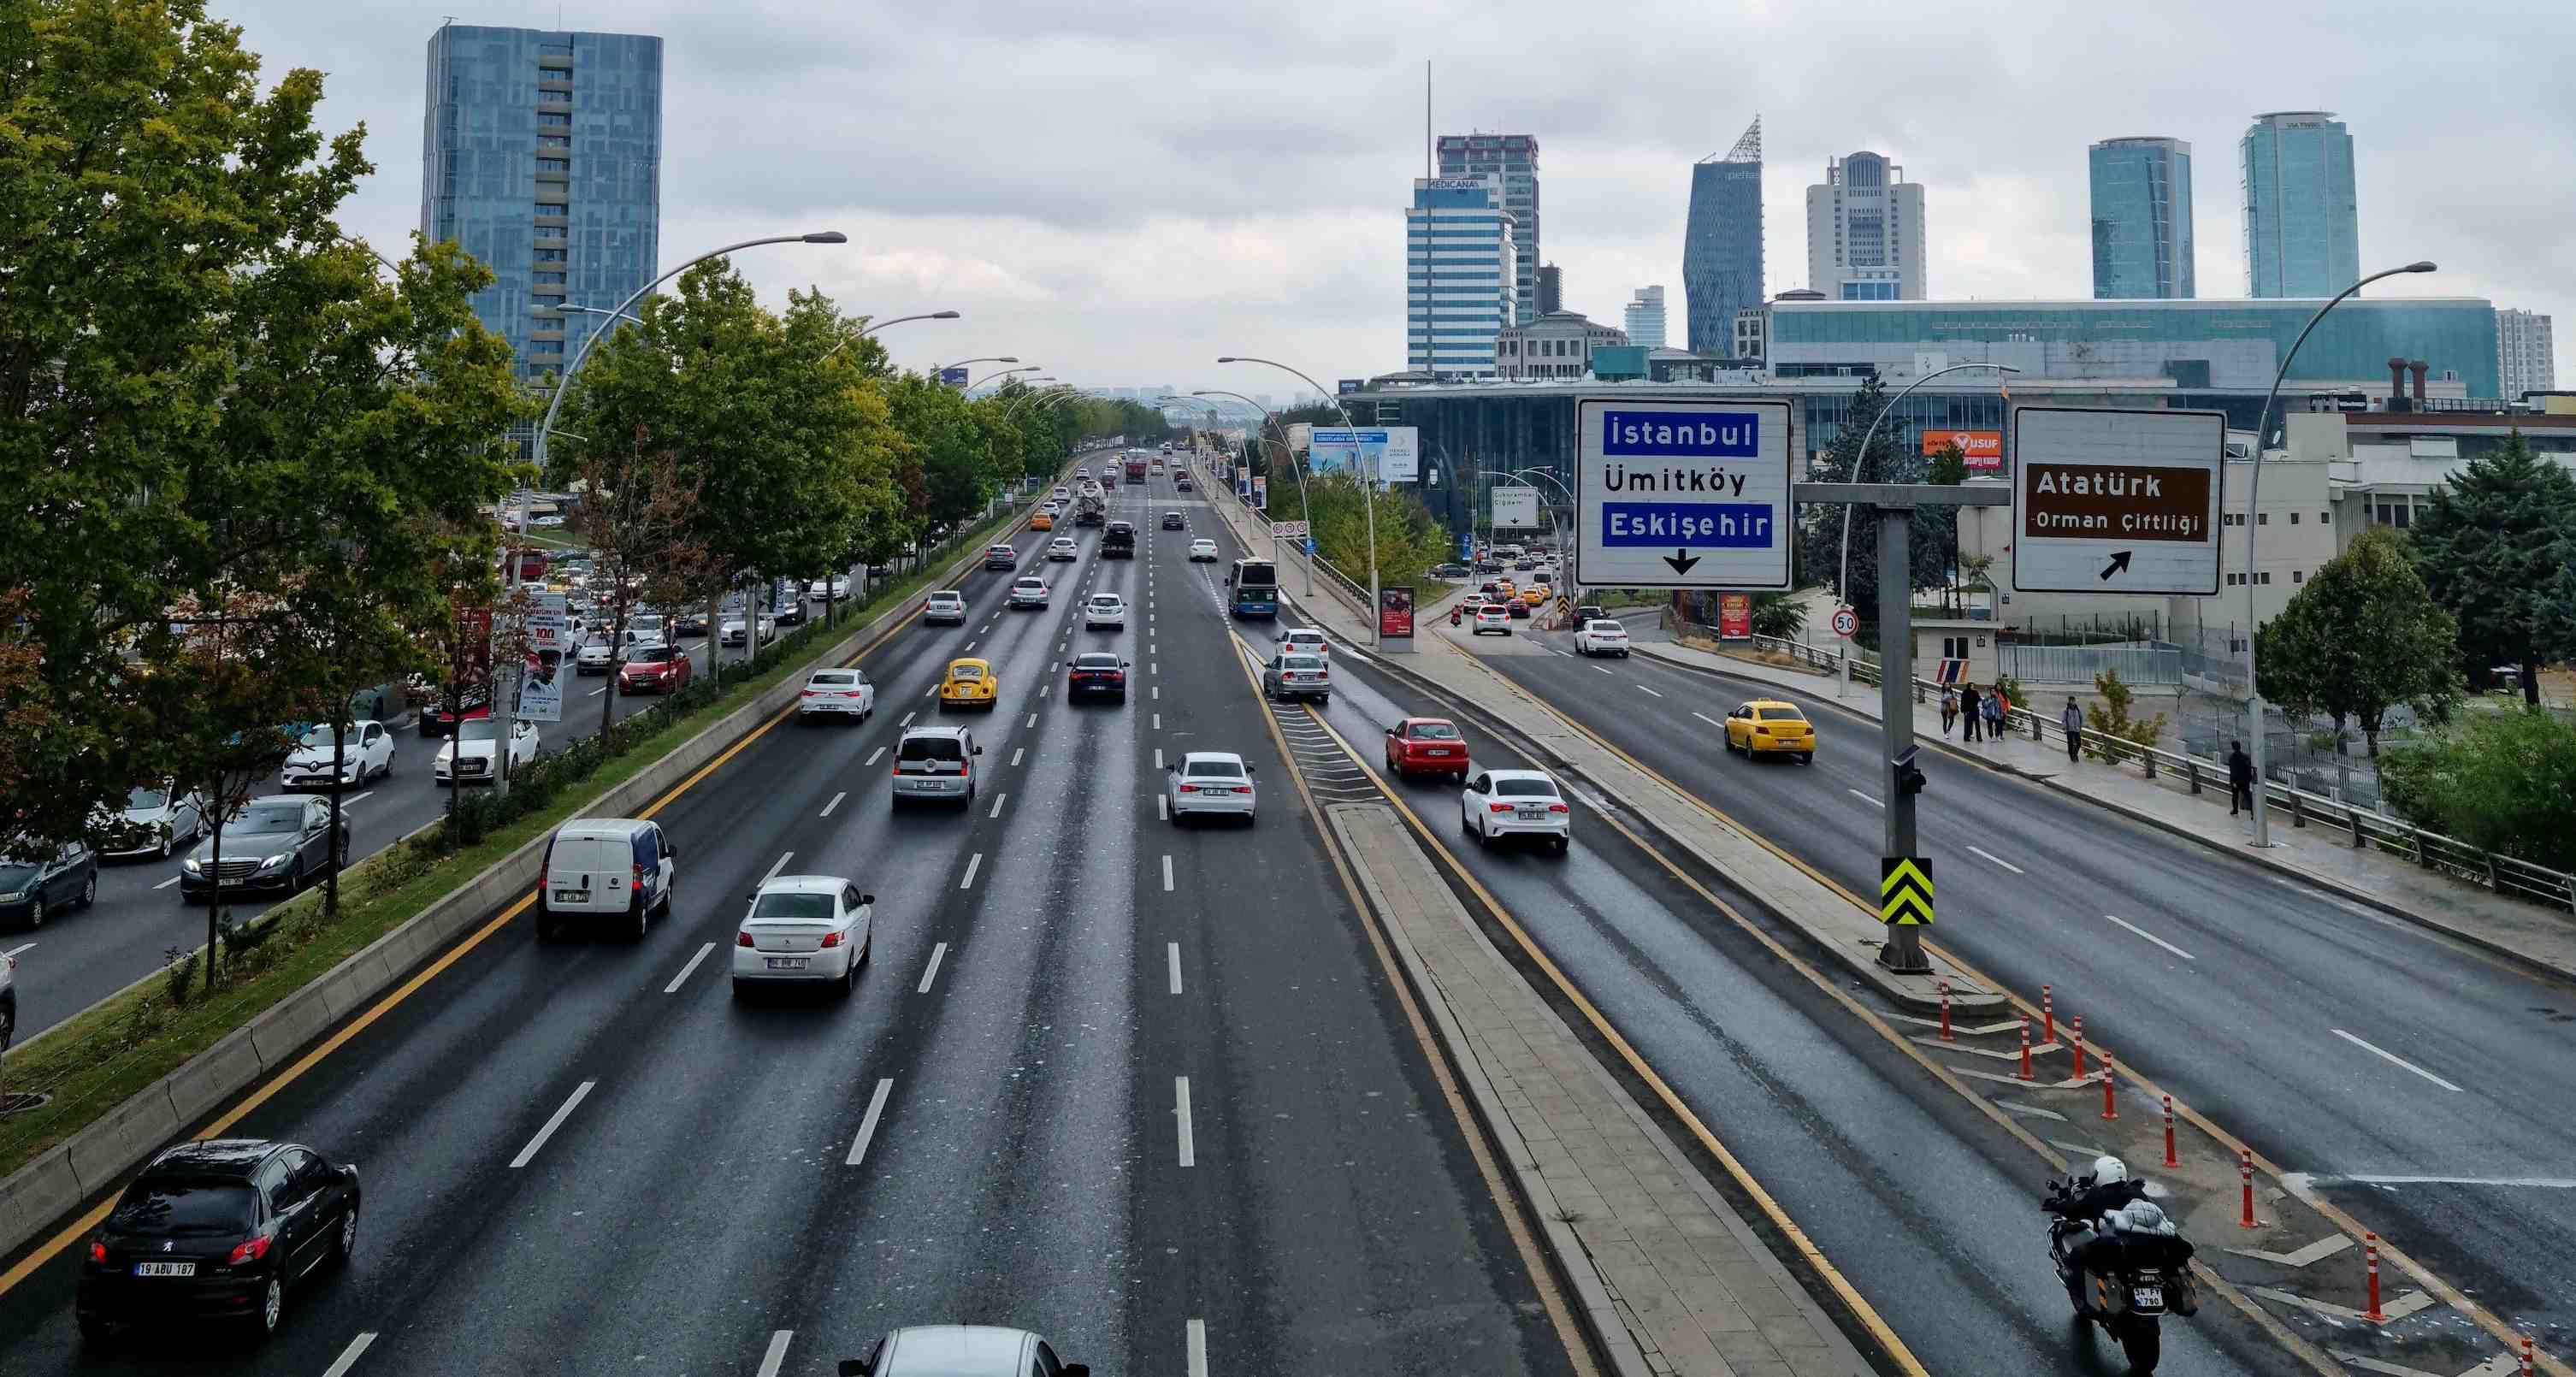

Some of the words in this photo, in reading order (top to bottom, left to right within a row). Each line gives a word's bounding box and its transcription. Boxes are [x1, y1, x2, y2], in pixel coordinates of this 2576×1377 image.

[1612, 417, 1751, 446] İstanbul
[1605, 464, 1746, 497] Ümitköy
[2036, 471, 2162, 497] Atatürk
[1610, 512, 1769, 540] Eskişehir
[2036, 511, 2108, 529] Orman
[2121, 513, 2199, 535] Çiftliği
[1837, 617, 1854, 629] 50
[141, 1264, 151, 1274] 19
[156, 1264, 172, 1274] ABU
